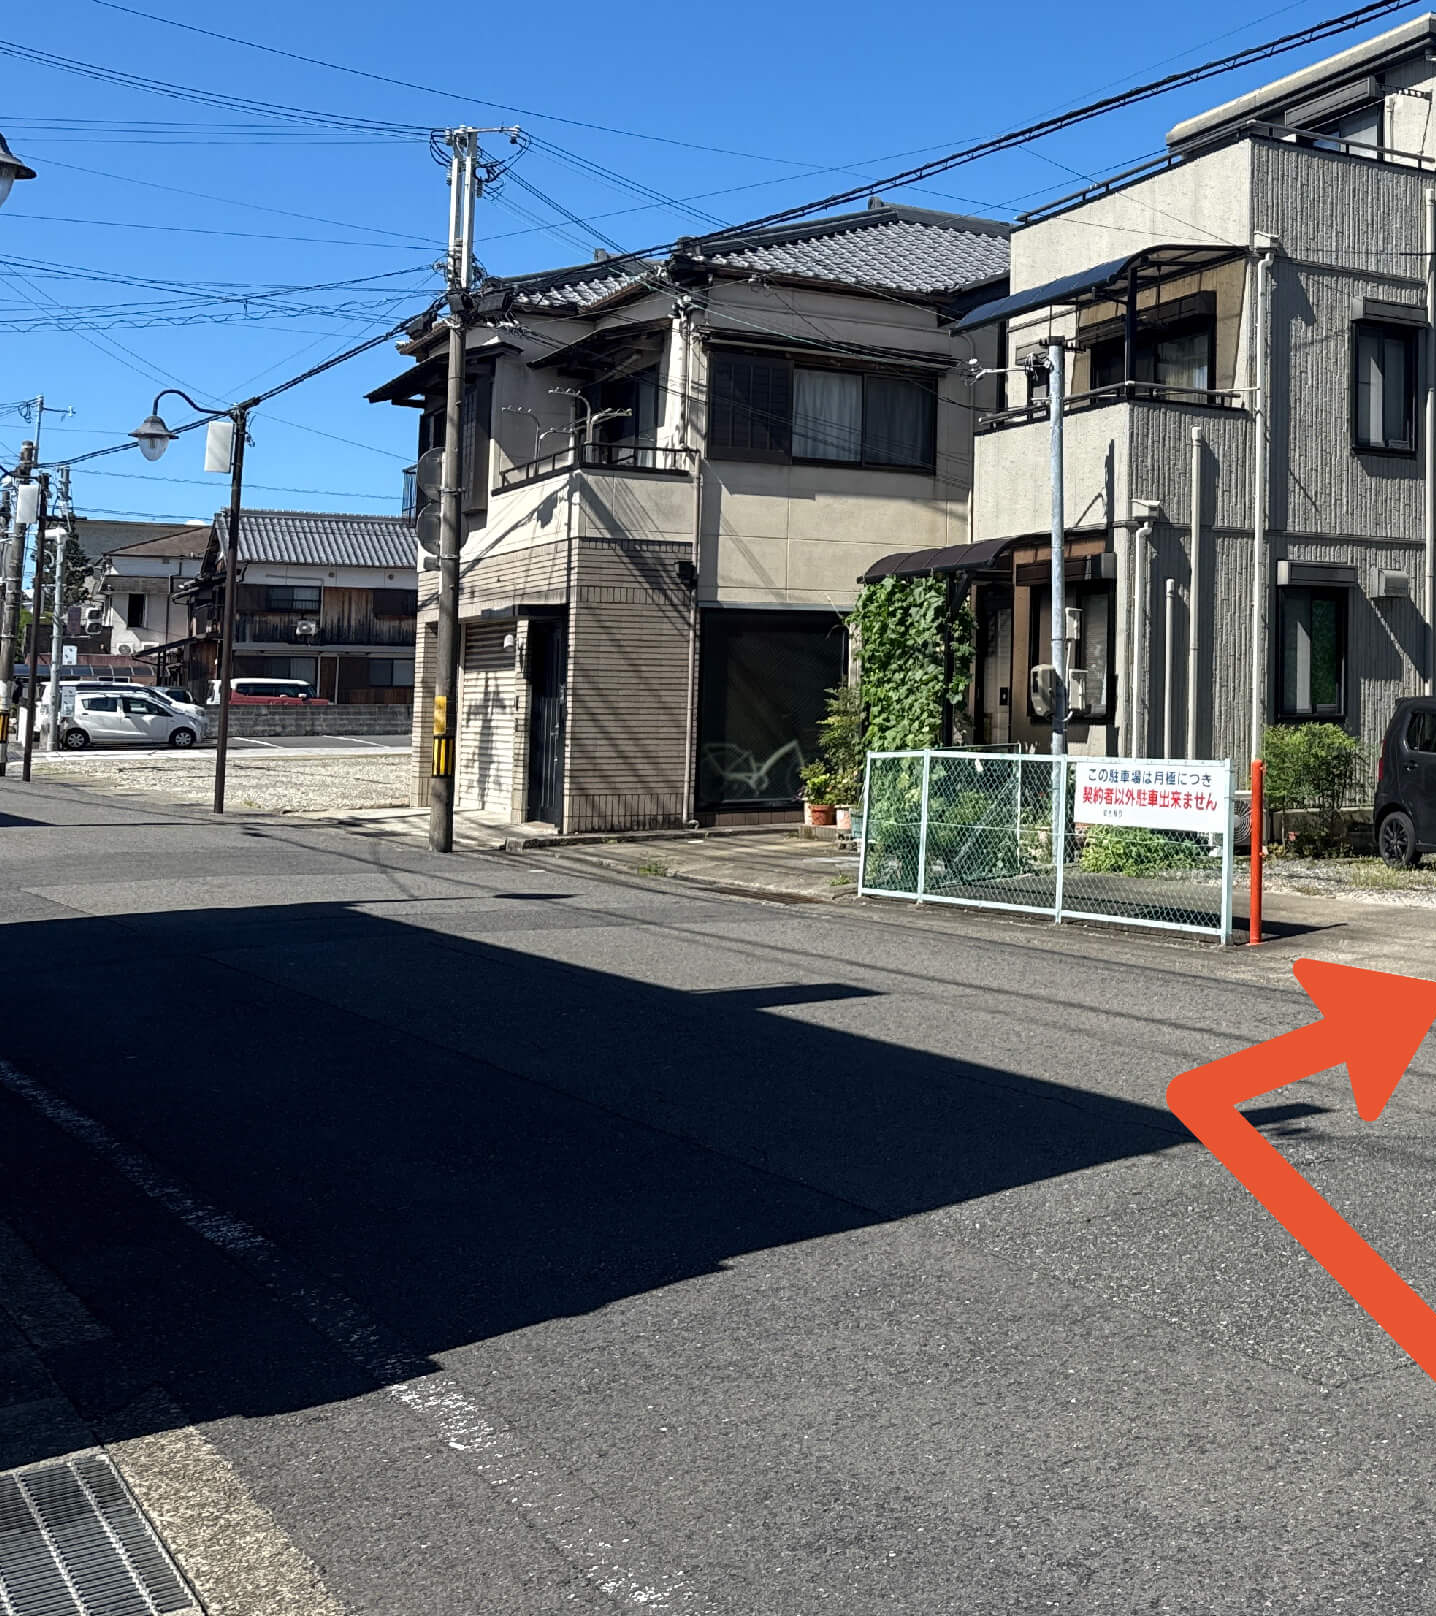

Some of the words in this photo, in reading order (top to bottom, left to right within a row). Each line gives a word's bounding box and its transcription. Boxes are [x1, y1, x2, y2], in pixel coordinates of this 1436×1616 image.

[1088, 768, 1213, 788] この駐車場は月極につき
[1082, 786, 1218, 811] 契約者以外駐車出来ません
